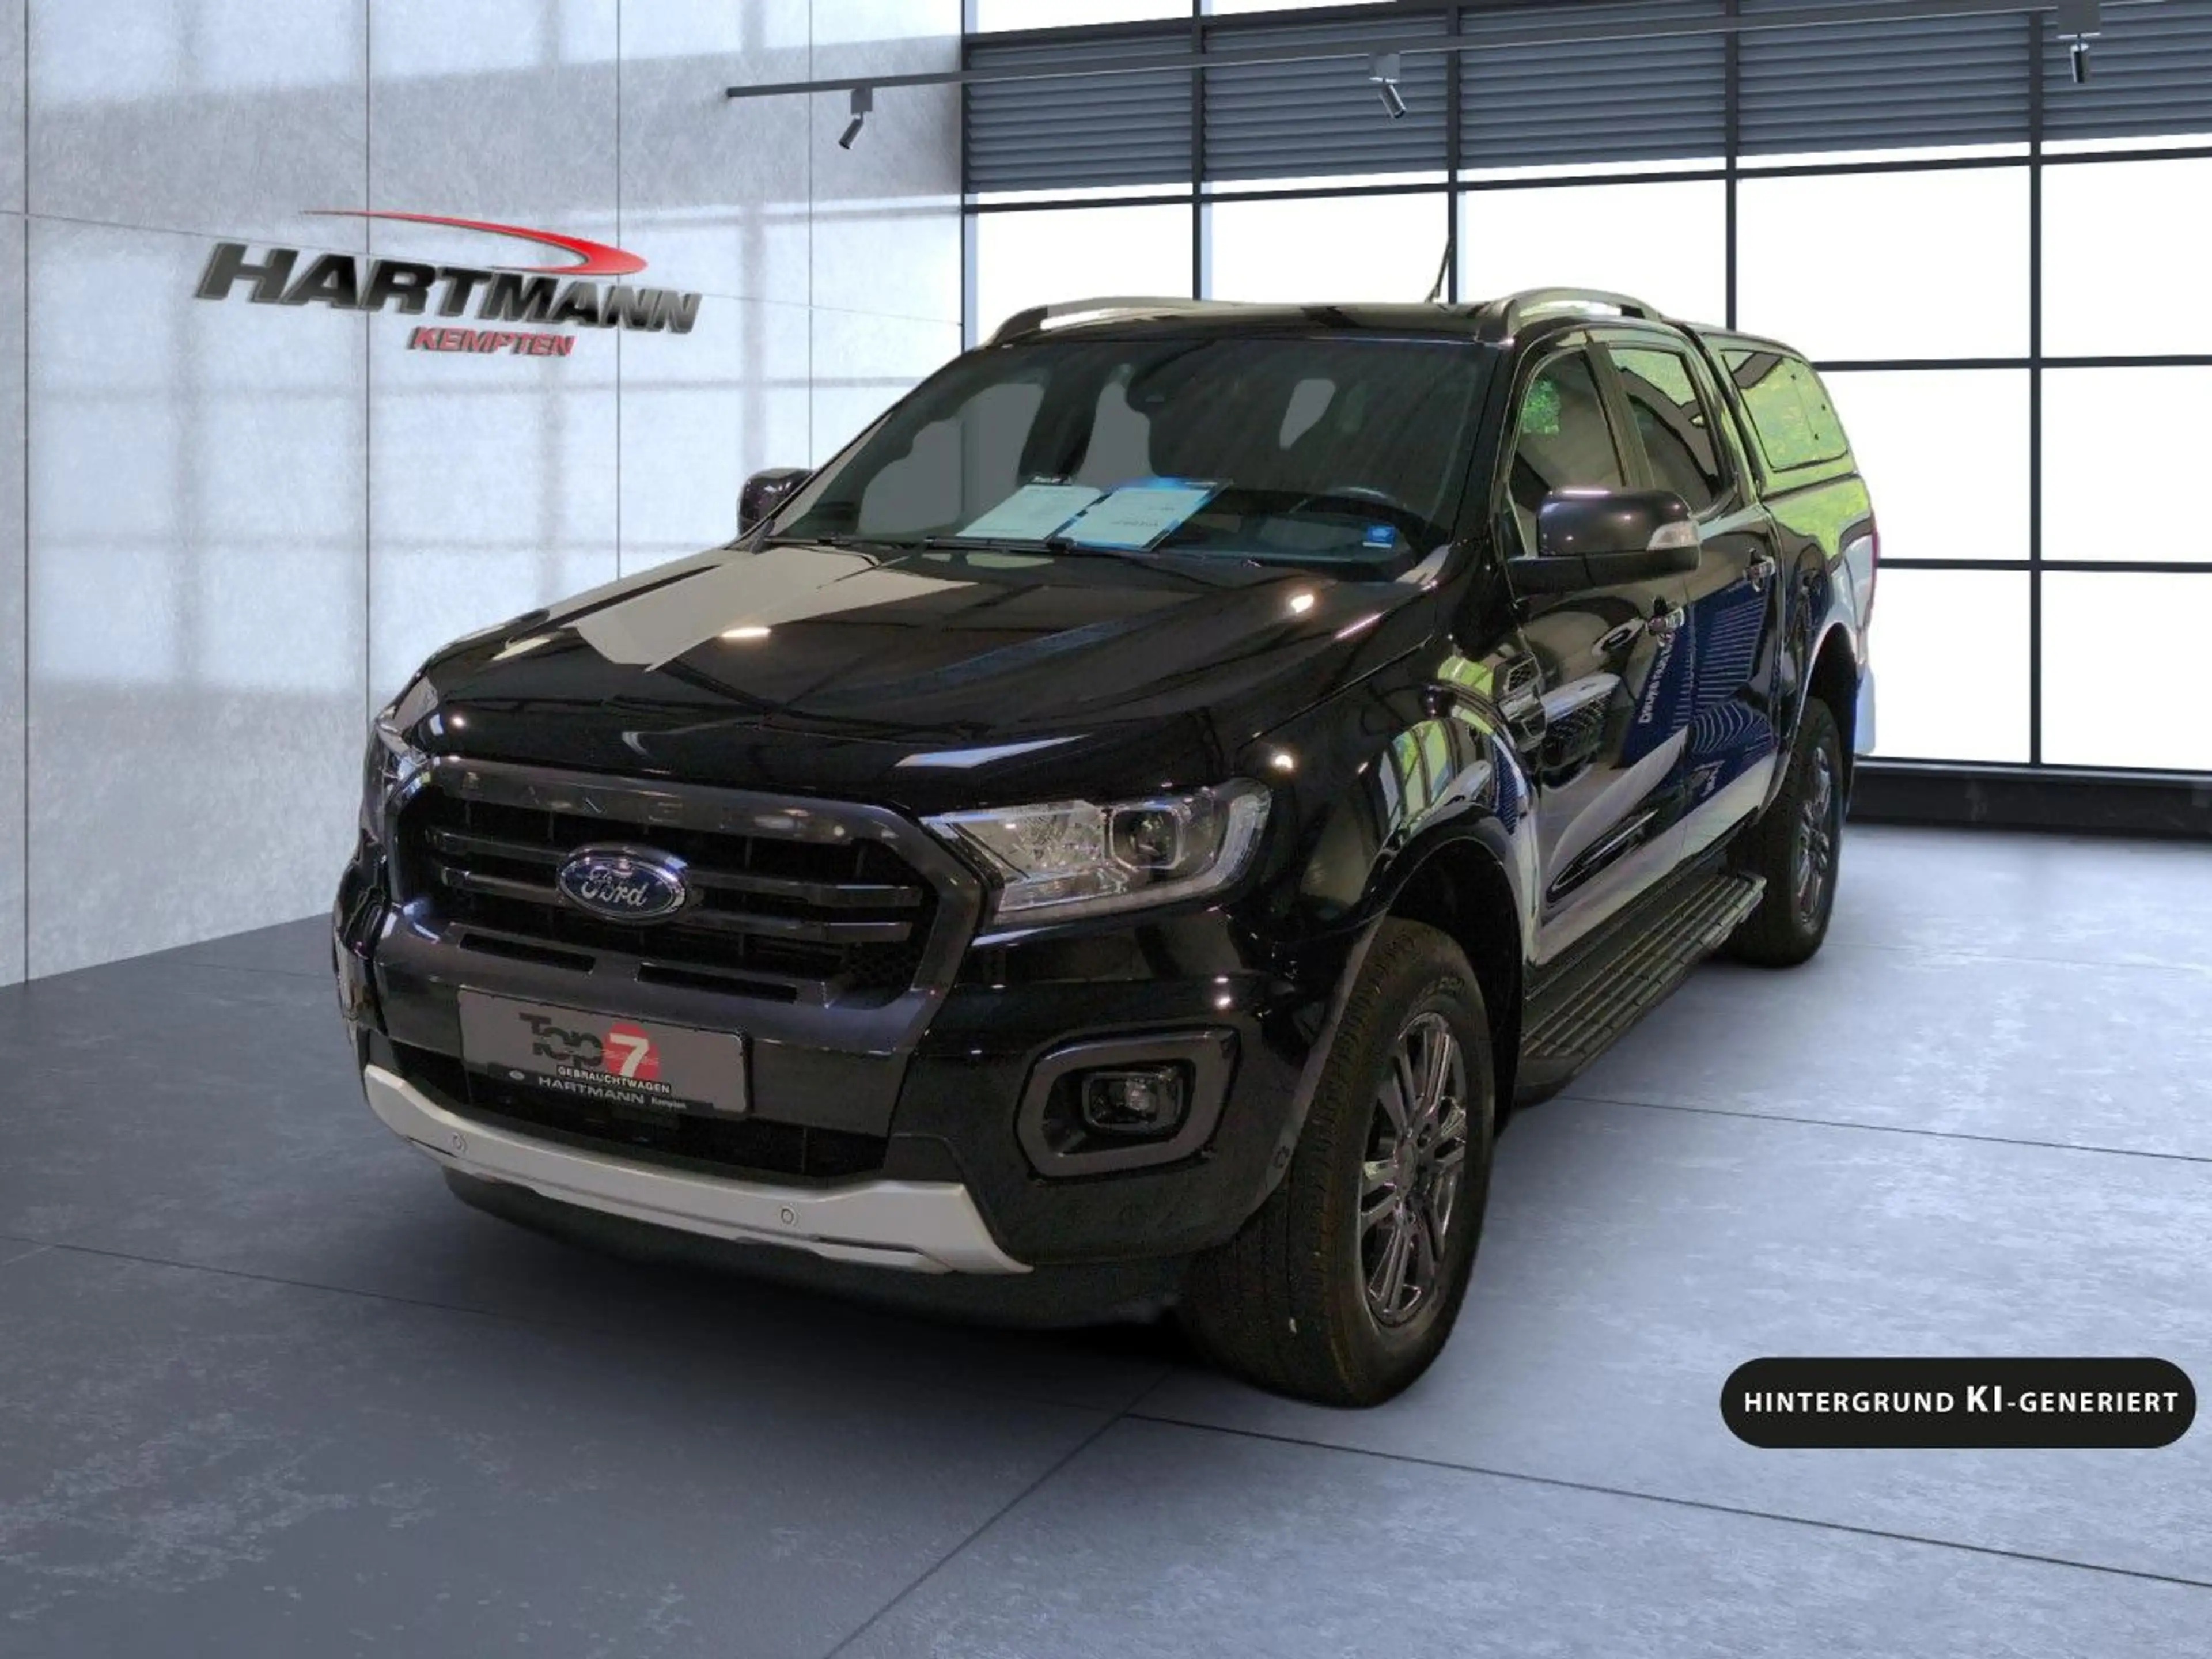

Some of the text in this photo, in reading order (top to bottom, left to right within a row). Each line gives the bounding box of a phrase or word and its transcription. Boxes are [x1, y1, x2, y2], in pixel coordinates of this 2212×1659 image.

[196, 242, 703, 334] HARTMANN
[406, 326, 575, 357] KEMPTEN
[581, 865, 649, 906] Ford
[520, 1013, 650, 1077] Top 7
[538, 1076, 645, 1105] HARTMANN
[557, 1065, 671, 1094] GEBRAUCHTWAGEN
